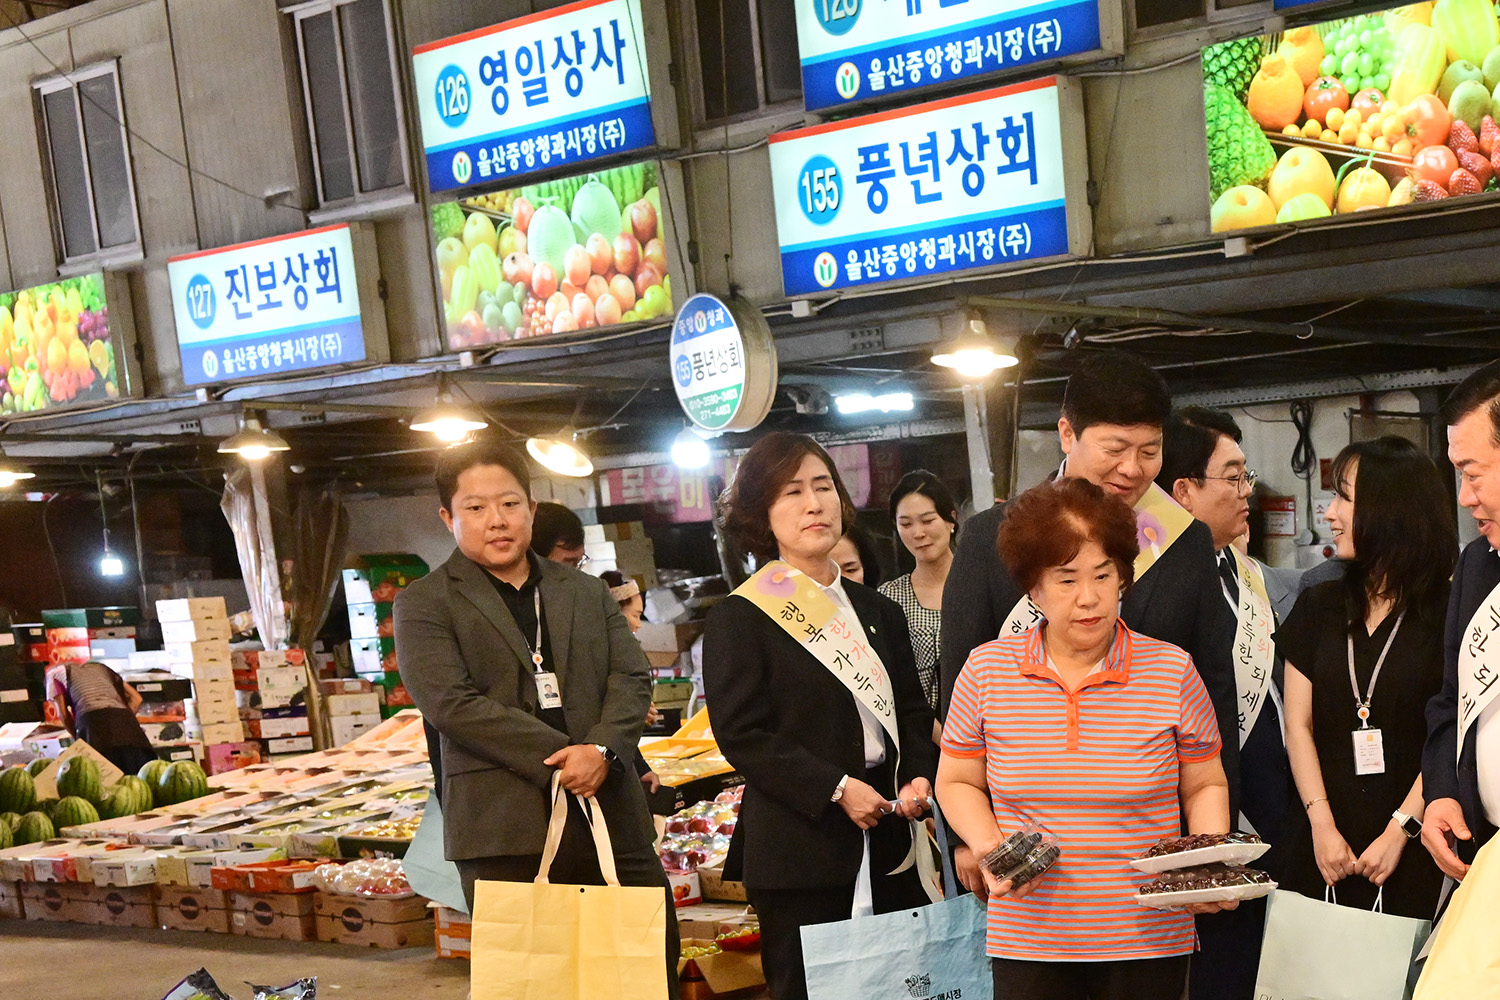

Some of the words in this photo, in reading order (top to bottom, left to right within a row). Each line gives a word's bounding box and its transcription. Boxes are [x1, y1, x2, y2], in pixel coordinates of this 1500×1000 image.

[437, 73, 470, 118] 126
[478, 18, 626, 116] 영일상사
[867, 18, 1062, 92] 울산중앙청과시장(주)
[476, 117, 626, 178] 울산중앙청과시장(주)
[801, 166, 840, 214] 155
[856, 111, 1038, 215] 풍년상회
[188, 283, 213, 320] 127
[224, 246, 343, 320] 진보상회
[844, 222, 1032, 282] 울산중앙청과시장(주)
[222, 332, 343, 374] 울산중앙청과시장(주)
[679, 317, 695, 336] 중앙
[706, 307, 725, 327] 청과
[676, 359, 691, 381] 155
[693, 340, 742, 381] 풍년상회
[780, 601, 827, 643] 행복
[833, 649, 891, 717] 가득한
[830, 617, 887, 687] 한가위
